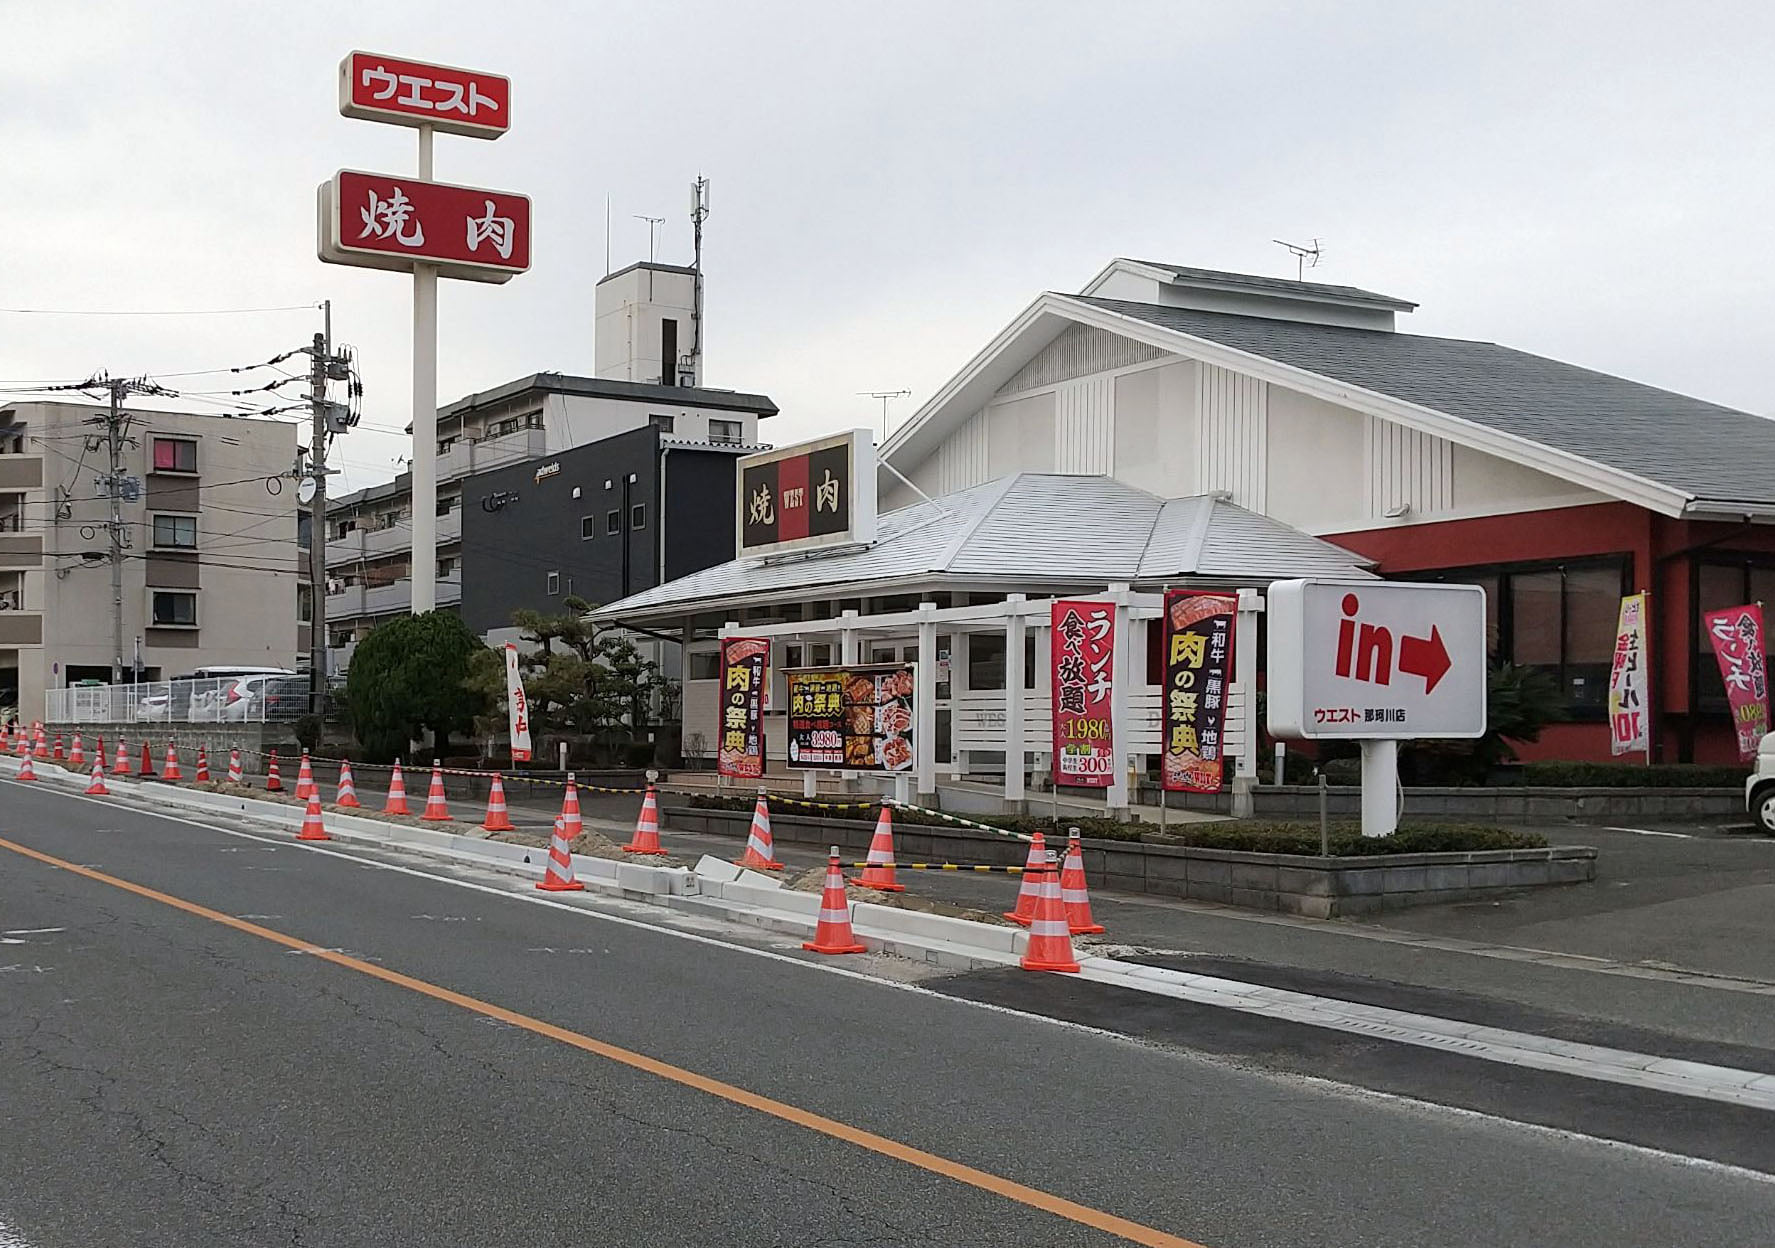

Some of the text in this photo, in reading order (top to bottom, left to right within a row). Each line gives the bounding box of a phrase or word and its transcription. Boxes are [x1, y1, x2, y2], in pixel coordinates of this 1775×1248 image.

[363, 66, 498, 116] ウエスト
[357, 186, 515, 259] 焼肉
[1058, 609, 1086, 714] 食べ放題
[1086, 611, 1111, 704] ランチ
[1336, 593, 1393, 686] in
[725, 665, 751, 753] 肉の祭典
[793, 693, 840, 713] 肉の祭典
[976, 713, 1006, 727] WES
[1169, 631, 1208, 756] 肉の祭典
[1314, 708, 1406, 723] ウエスト 那珂川店
[1079, 757, 1107, 773] 300
